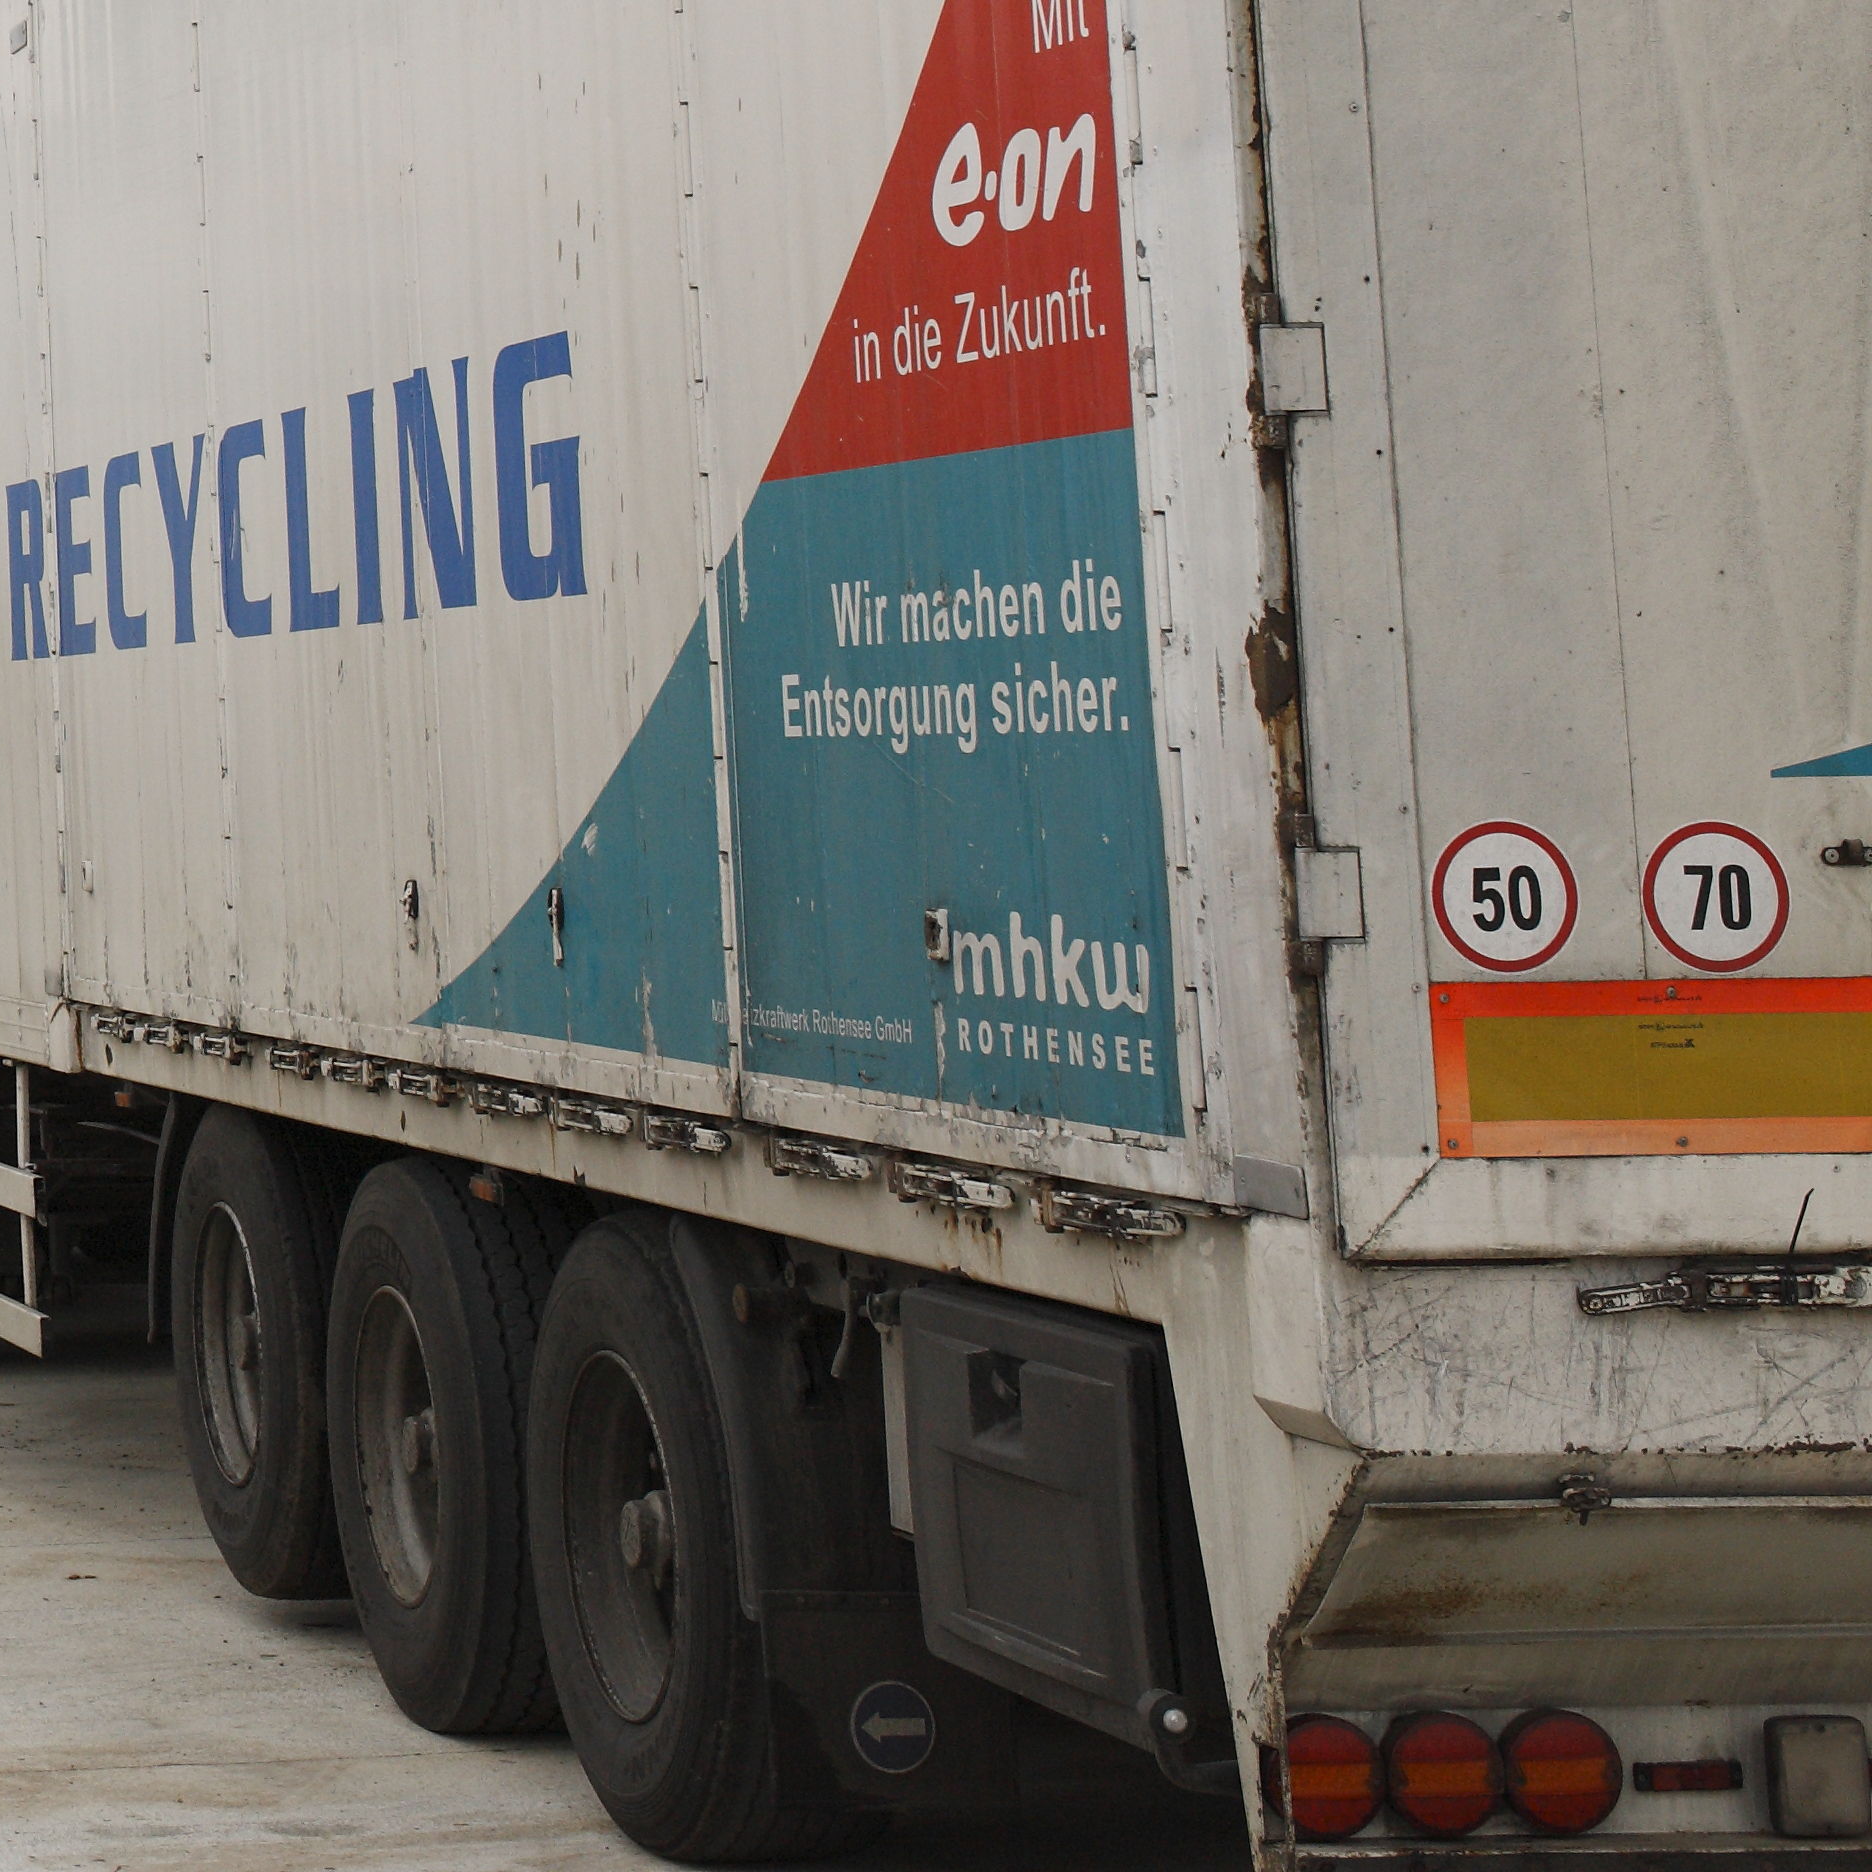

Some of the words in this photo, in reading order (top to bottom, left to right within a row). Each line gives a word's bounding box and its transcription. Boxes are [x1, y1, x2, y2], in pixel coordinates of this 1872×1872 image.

[853, 319, 882, 384] in
[893, 304, 942, 377] die
[954, 266, 1106, 364] Zukunft.
[5, 331, 588, 661] RECYCLING
[831, 579, 887, 648] Wir
[900, 568, 1046, 643] machen
[1059, 558, 1122, 634] die
[781, 673, 978, 755] Entsorgung
[991, 660, 1130, 735] sicher.
[1472, 865, 1542, 932] 50
[1683, 864, 1752, 931] 70
[953, 911, 1149, 1014] mhkw
[812, 1008, 872, 1041] Rothensee
[874, 1015, 913, 1044] GmbH
[958, 1017, 1155, 1076] ROTHENSEE
